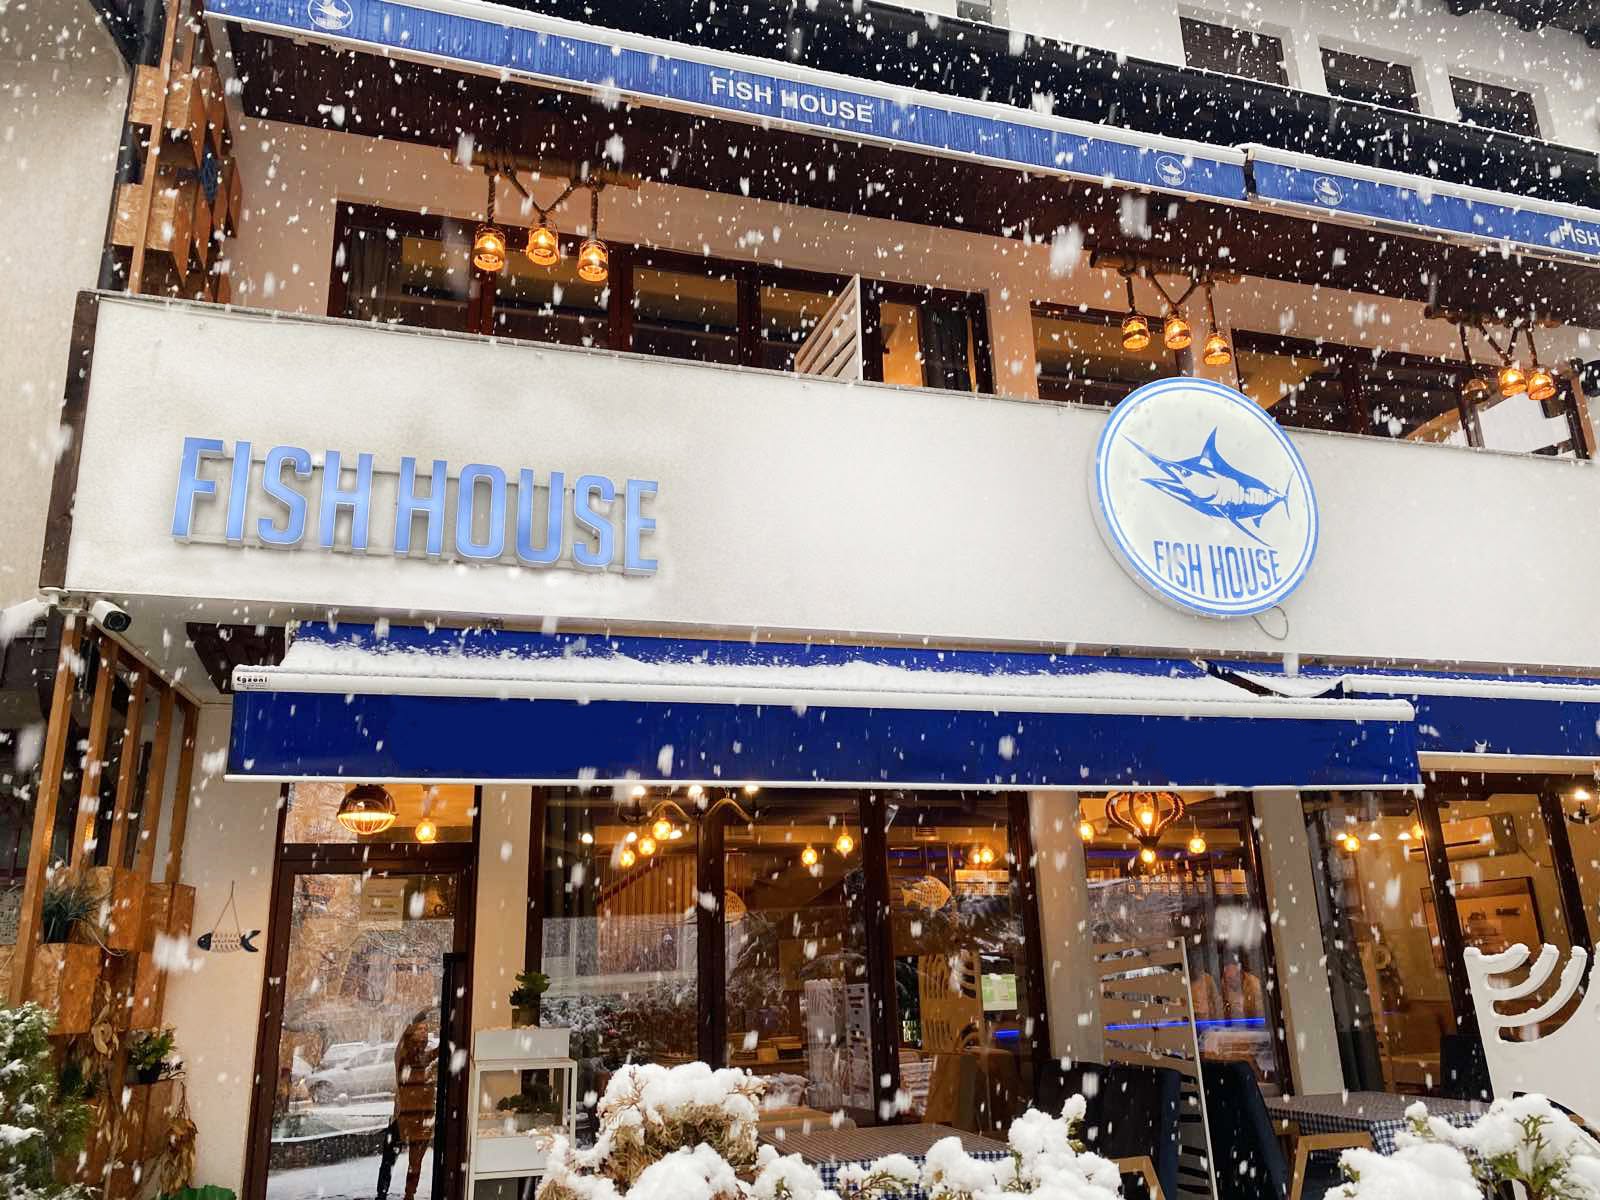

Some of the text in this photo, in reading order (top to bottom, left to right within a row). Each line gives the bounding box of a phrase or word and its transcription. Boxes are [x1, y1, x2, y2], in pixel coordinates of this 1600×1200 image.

[711, 76, 873, 123] FISH HOUSE
[171, 436, 659, 575] FISH HOUSE
[1153, 540, 1282, 599] FISH HOUSE
